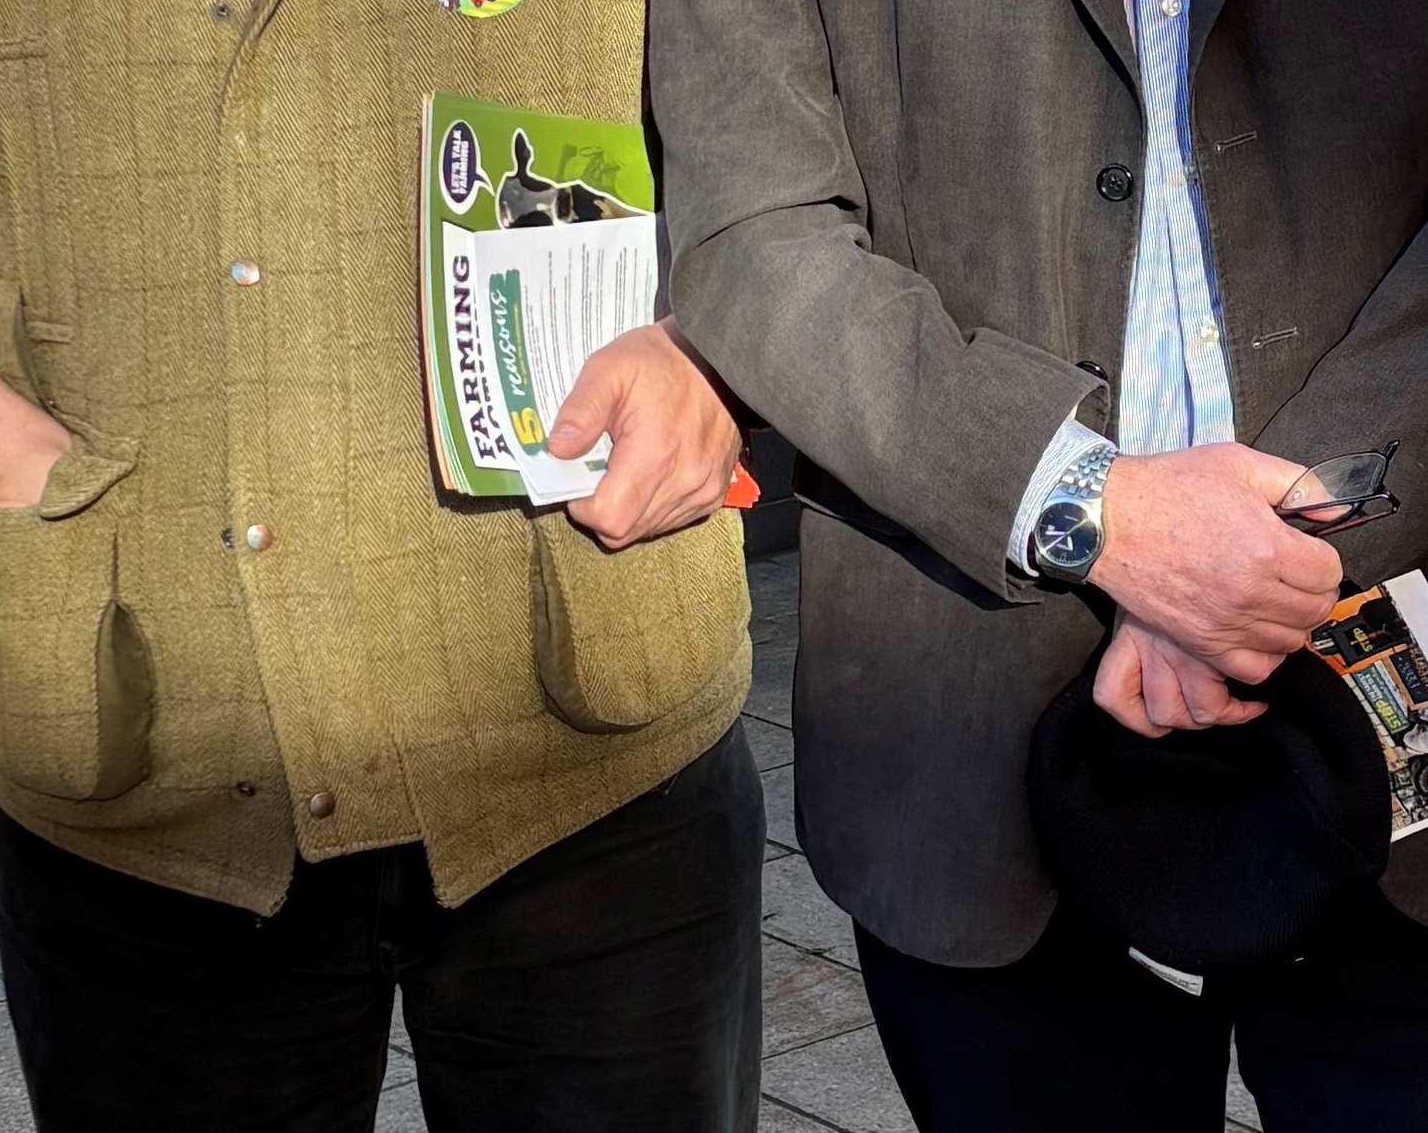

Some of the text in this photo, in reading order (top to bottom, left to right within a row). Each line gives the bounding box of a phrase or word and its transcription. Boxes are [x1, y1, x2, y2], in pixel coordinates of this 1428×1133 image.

[452, 254, 497, 461] FARMING
[490, 287, 526, 396] reasons
[510, 406, 545, 446] 5
